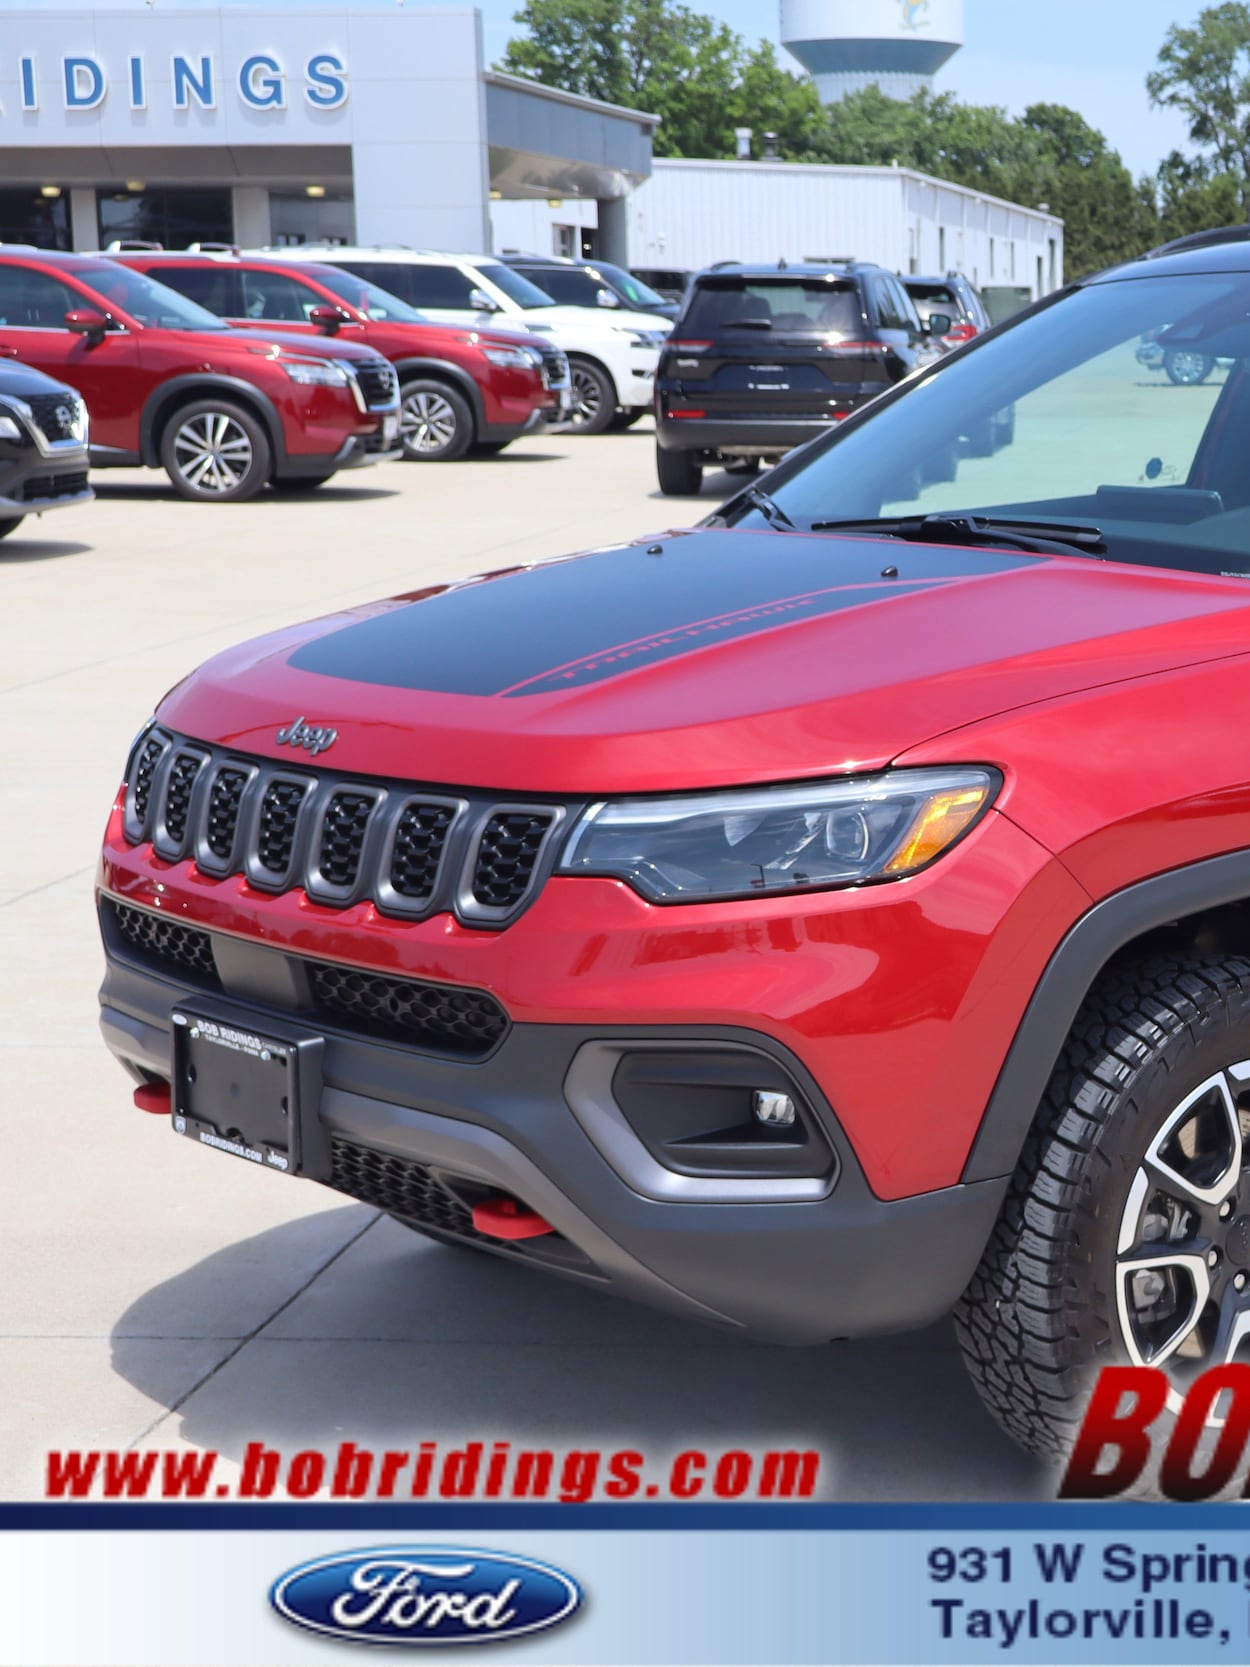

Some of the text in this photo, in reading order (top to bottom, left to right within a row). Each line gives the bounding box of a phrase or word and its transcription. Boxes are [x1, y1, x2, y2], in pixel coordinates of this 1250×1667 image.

[0, 54, 350, 111] IDINGS
[275, 715, 338, 757] Jeep
[197, 1020, 219, 1037] BOB
[219, 1026, 262, 1050] RIDINGS
[200, 1131, 263, 1163] BOBRIDINGS.COM
[267, 1150, 289, 1171] Jeep
